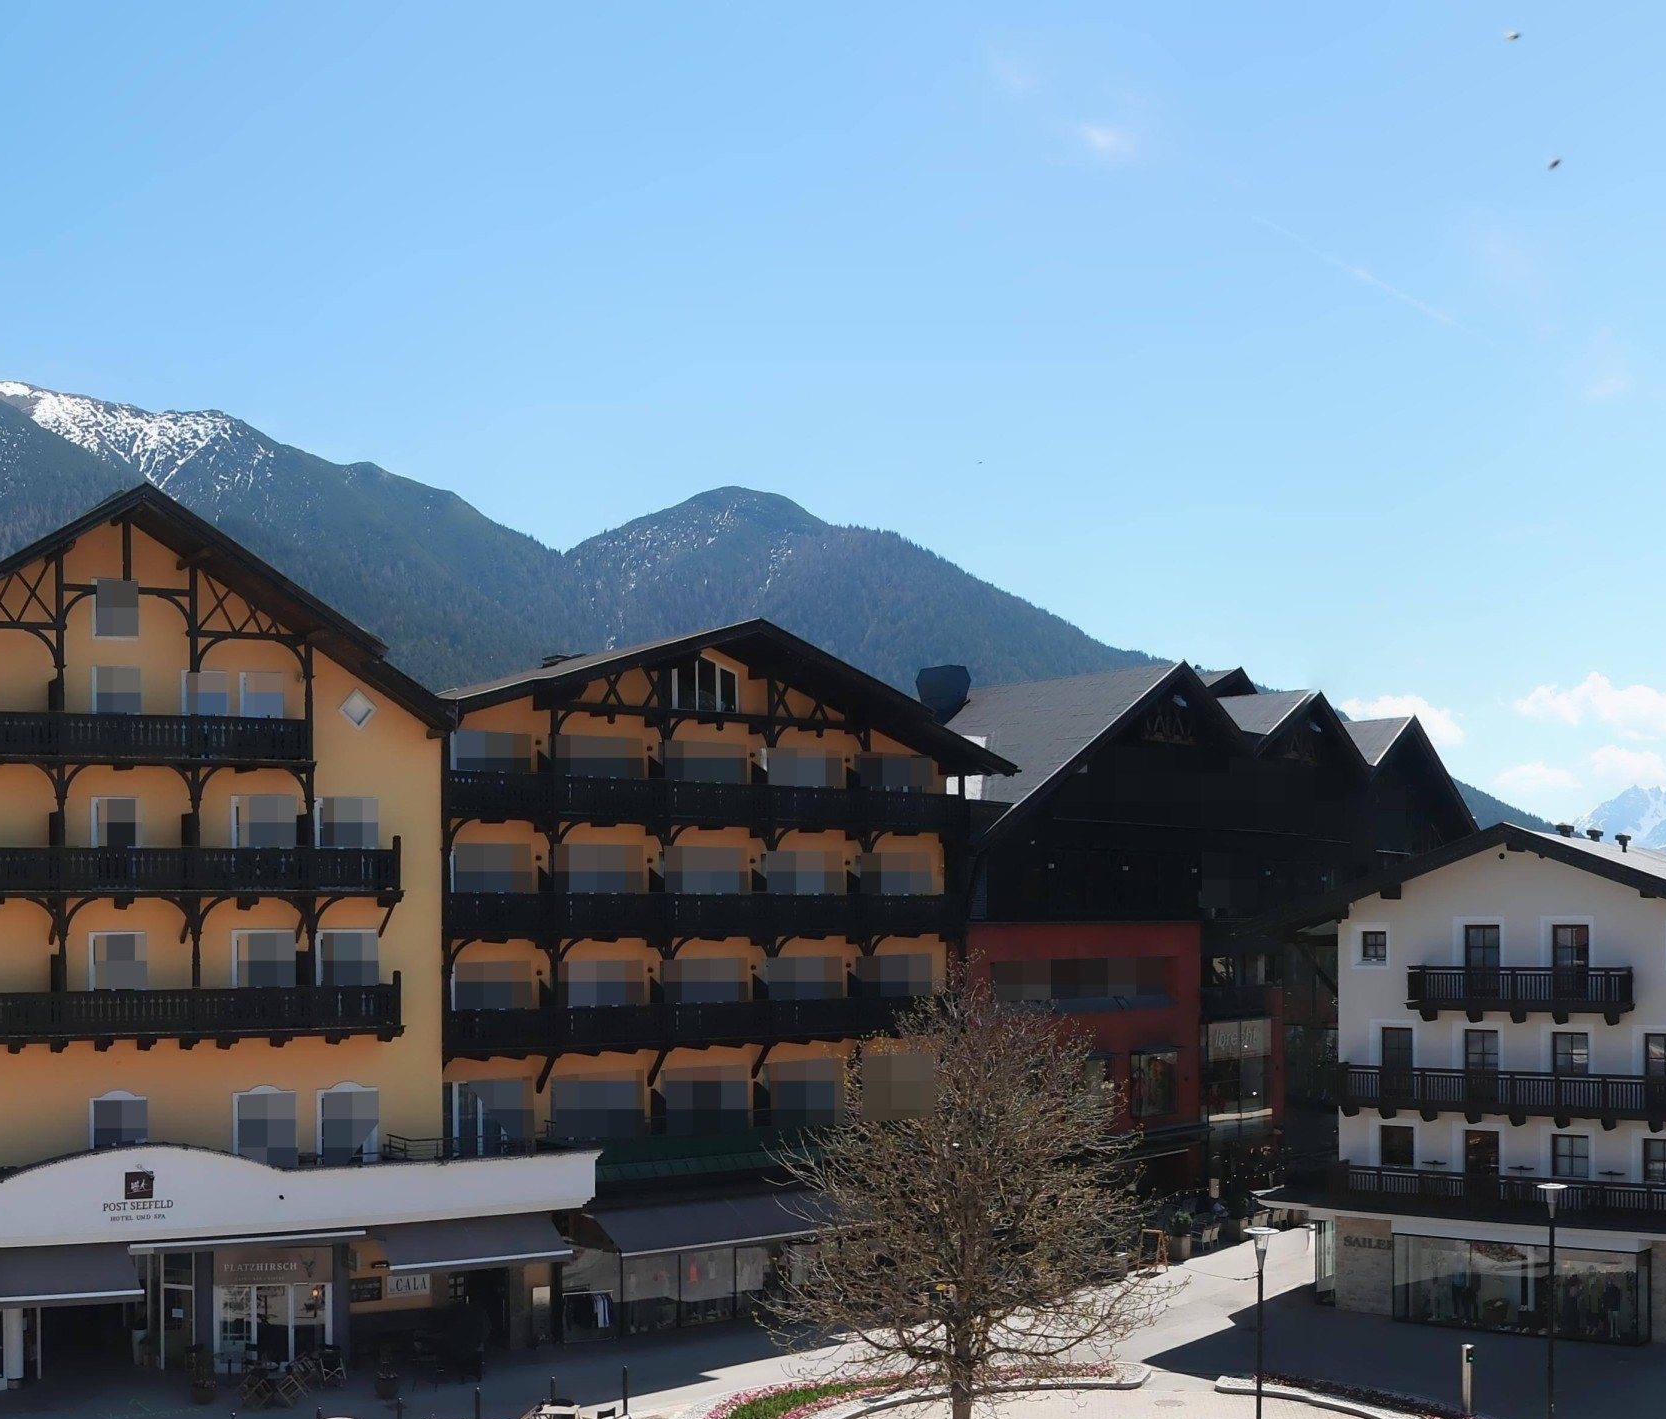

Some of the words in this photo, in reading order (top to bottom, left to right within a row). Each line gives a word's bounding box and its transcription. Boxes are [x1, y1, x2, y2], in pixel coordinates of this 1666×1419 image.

[102, 1201, 127, 1212] POST
[130, 1199, 174, 1211] SEEFELD
[223, 1261, 298, 1272] PLATZHIRSCH
[395, 1276, 427, 1292] CALA
